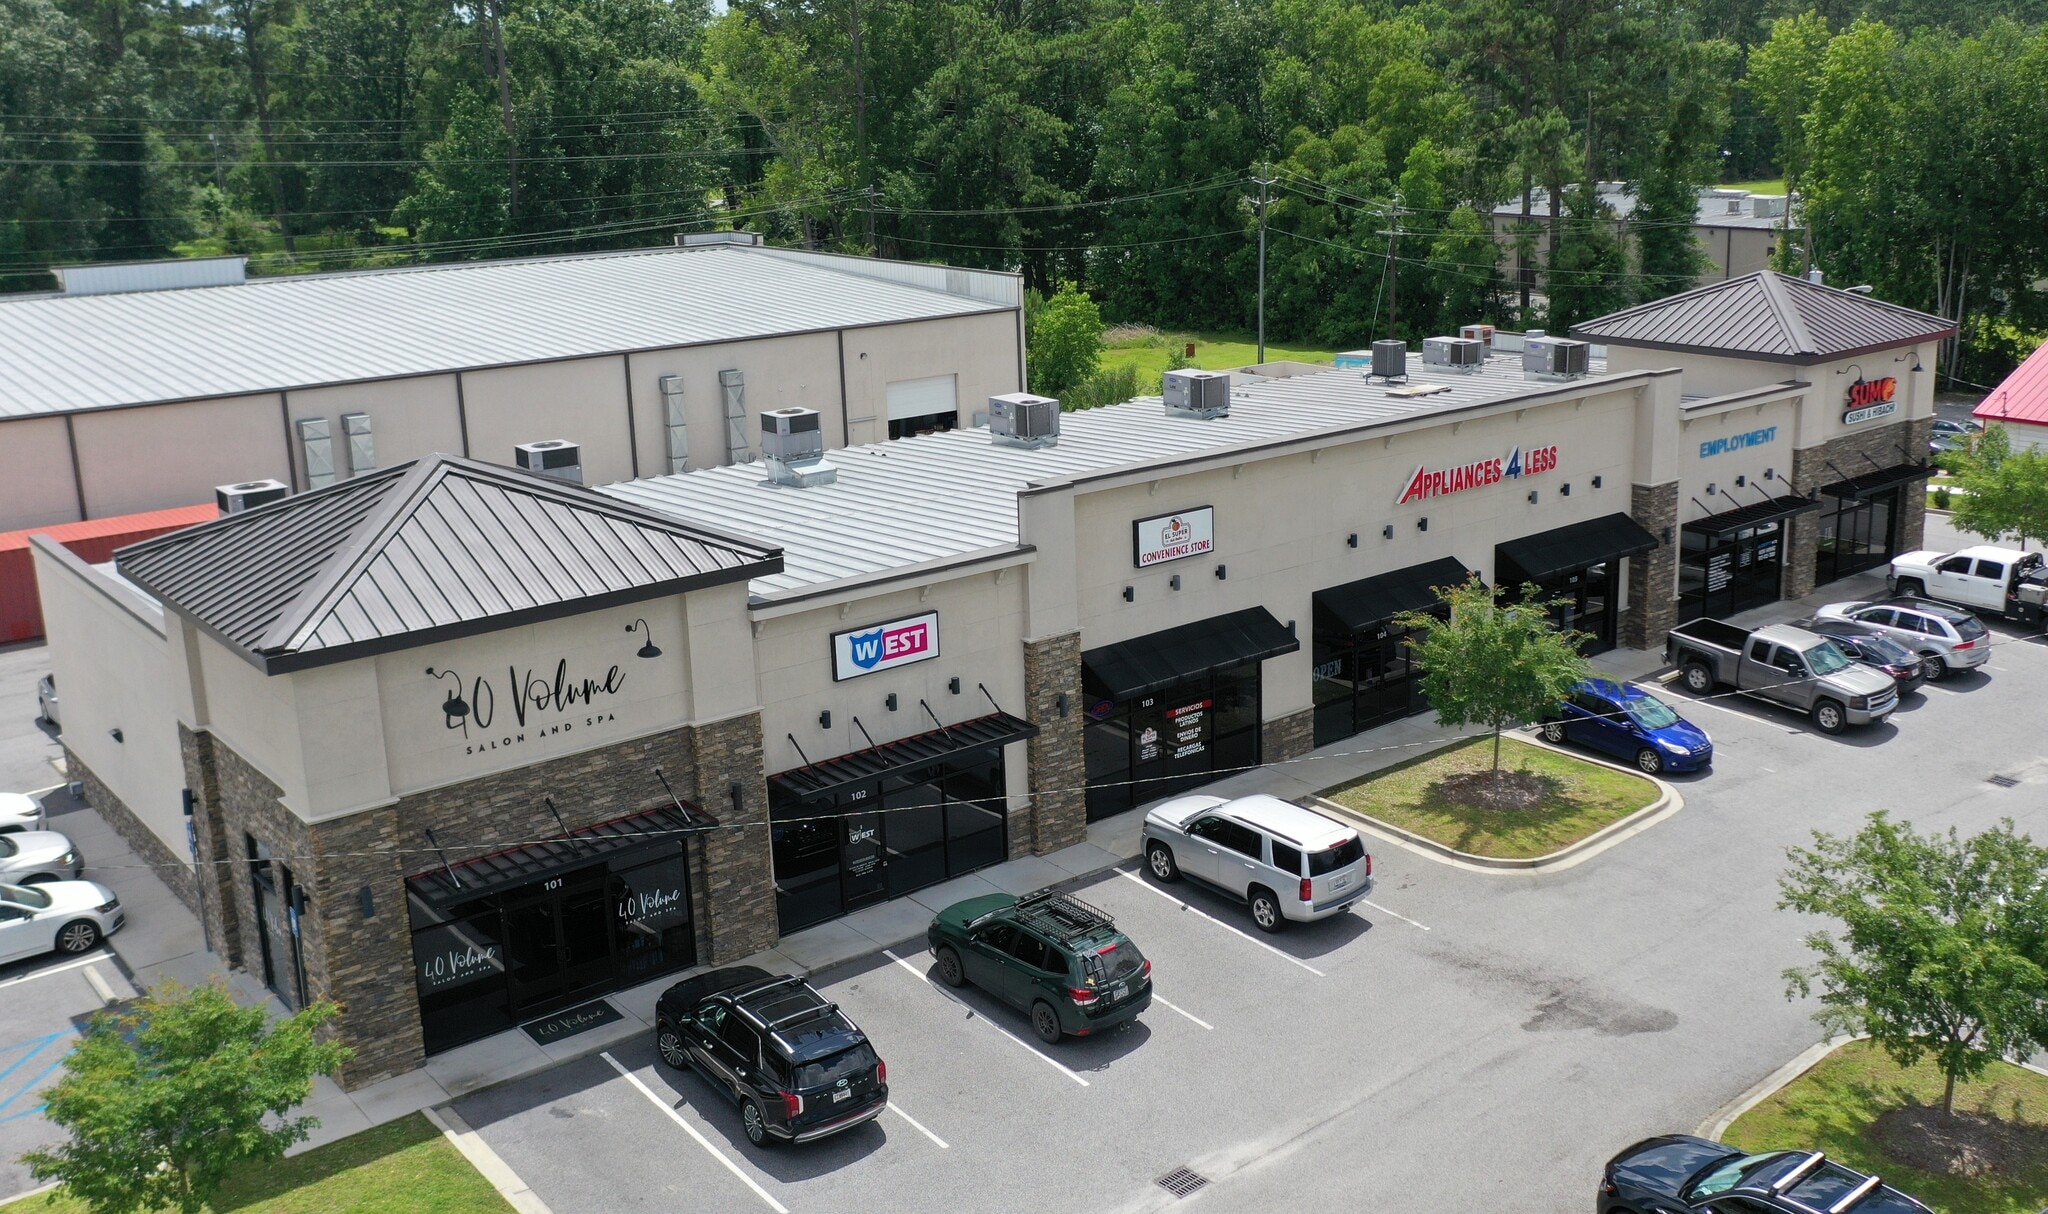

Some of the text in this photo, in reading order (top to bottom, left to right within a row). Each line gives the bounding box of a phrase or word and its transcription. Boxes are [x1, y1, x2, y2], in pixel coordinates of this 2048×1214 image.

[1849, 410, 1866, 423] SUSHI
[1873, 403, 1895, 418] HIBACHI
[1700, 427, 1777, 458] EMPLOYMENT
[1397, 445, 1558, 504] APPLIANCES 4 LESS
[1172, 529, 1187, 537] SUPER
[1142, 539, 1210, 563] CONVENIENCE STORE
[1377, 631, 1387, 640] 104
[855, 628, 925, 661] WEST
[1313, 659, 1342, 682] OPEN
[510, 658, 626, 727] Volume
[1142, 698, 1154, 708] 103
[1175, 701, 1203, 715] SERVICIOS
[1175, 711, 1203, 723] PRODUCTOS
[1179, 718, 1199, 727] LATINOS
[466, 713, 615, 755] SALON AND SPA
[1177, 742, 1202, 753] RECARGAS
[851, 790, 867, 801] 102
[851, 829, 875, 842] WEST
[544, 878, 563, 891] 101
[619, 889, 680, 920] 40 Volume
[426, 946, 496, 980] 40 Volume
